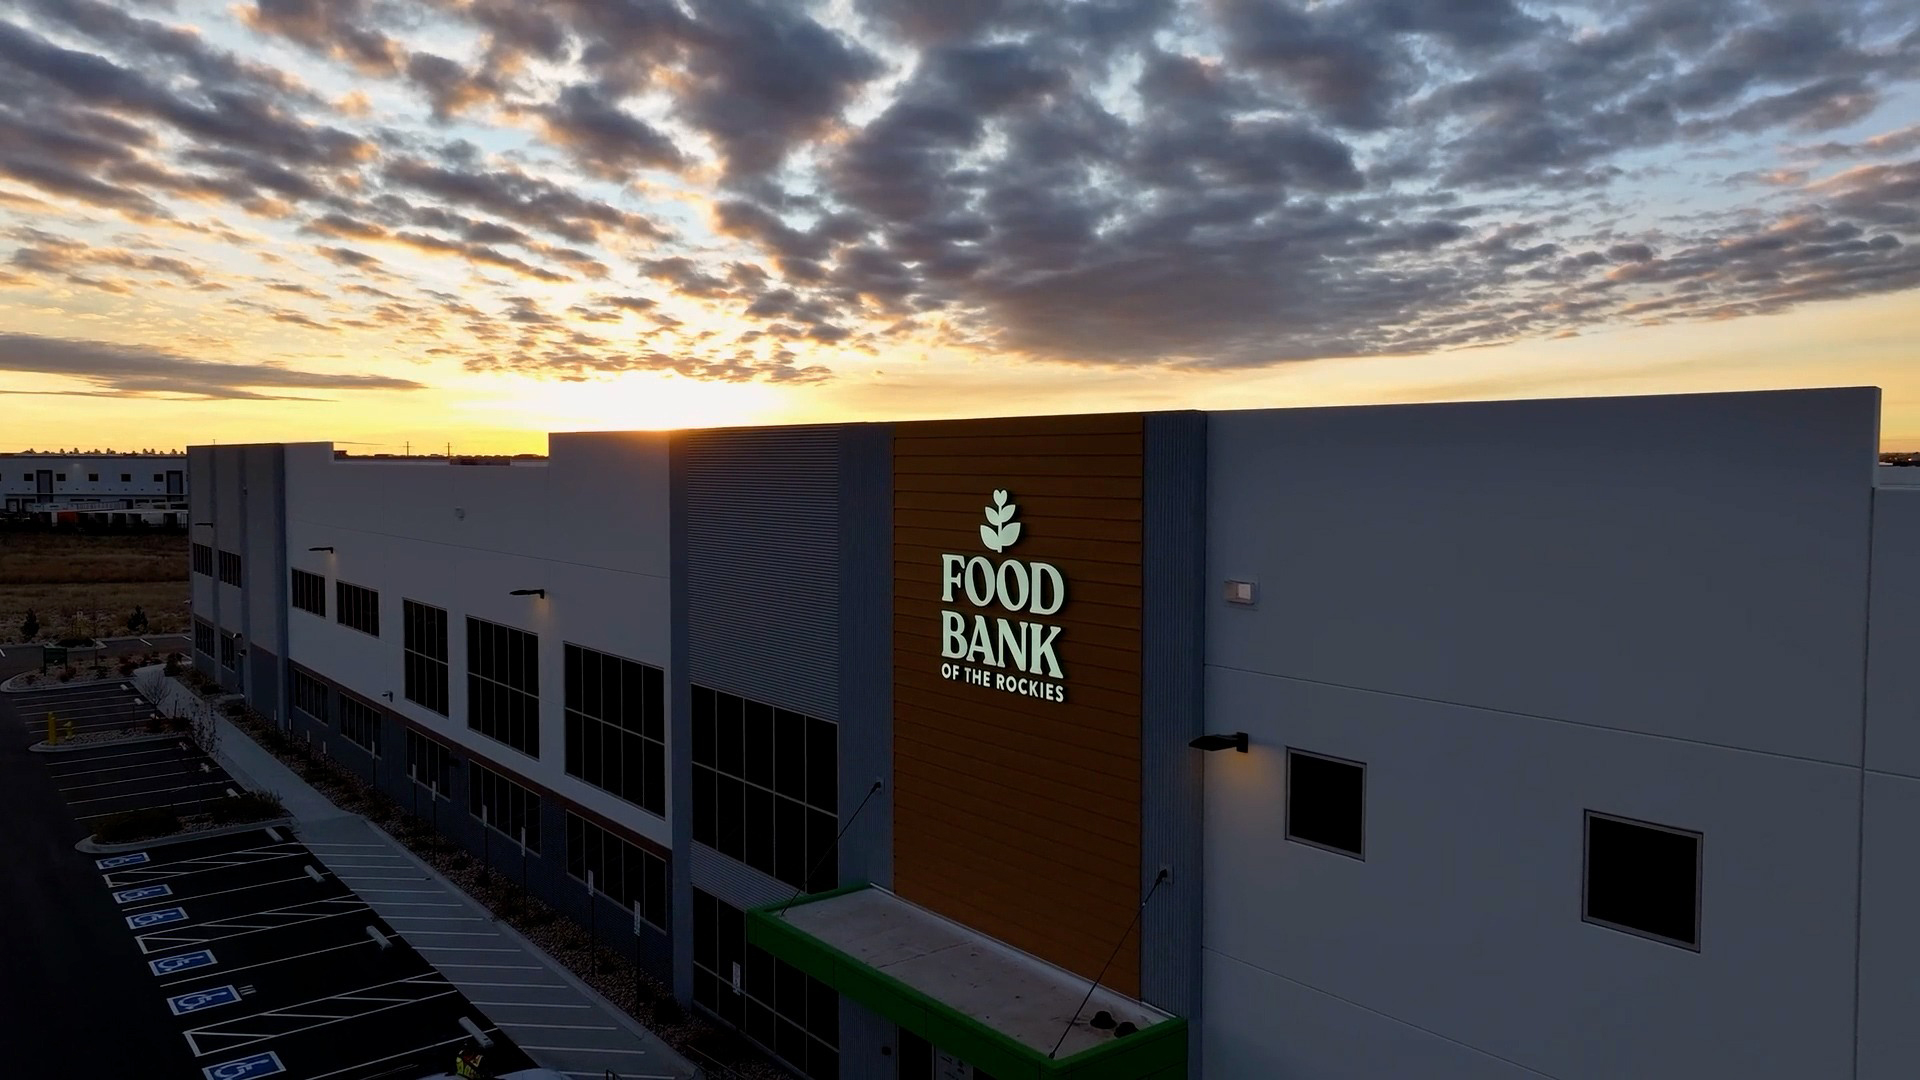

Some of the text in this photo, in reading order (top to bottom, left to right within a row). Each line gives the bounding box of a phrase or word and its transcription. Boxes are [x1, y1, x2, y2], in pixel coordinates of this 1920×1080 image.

[942, 554, 1065, 615] FOOD
[941, 610, 1064, 679] BANK
[941, 663, 1064, 702] OF THE ROCKIES
